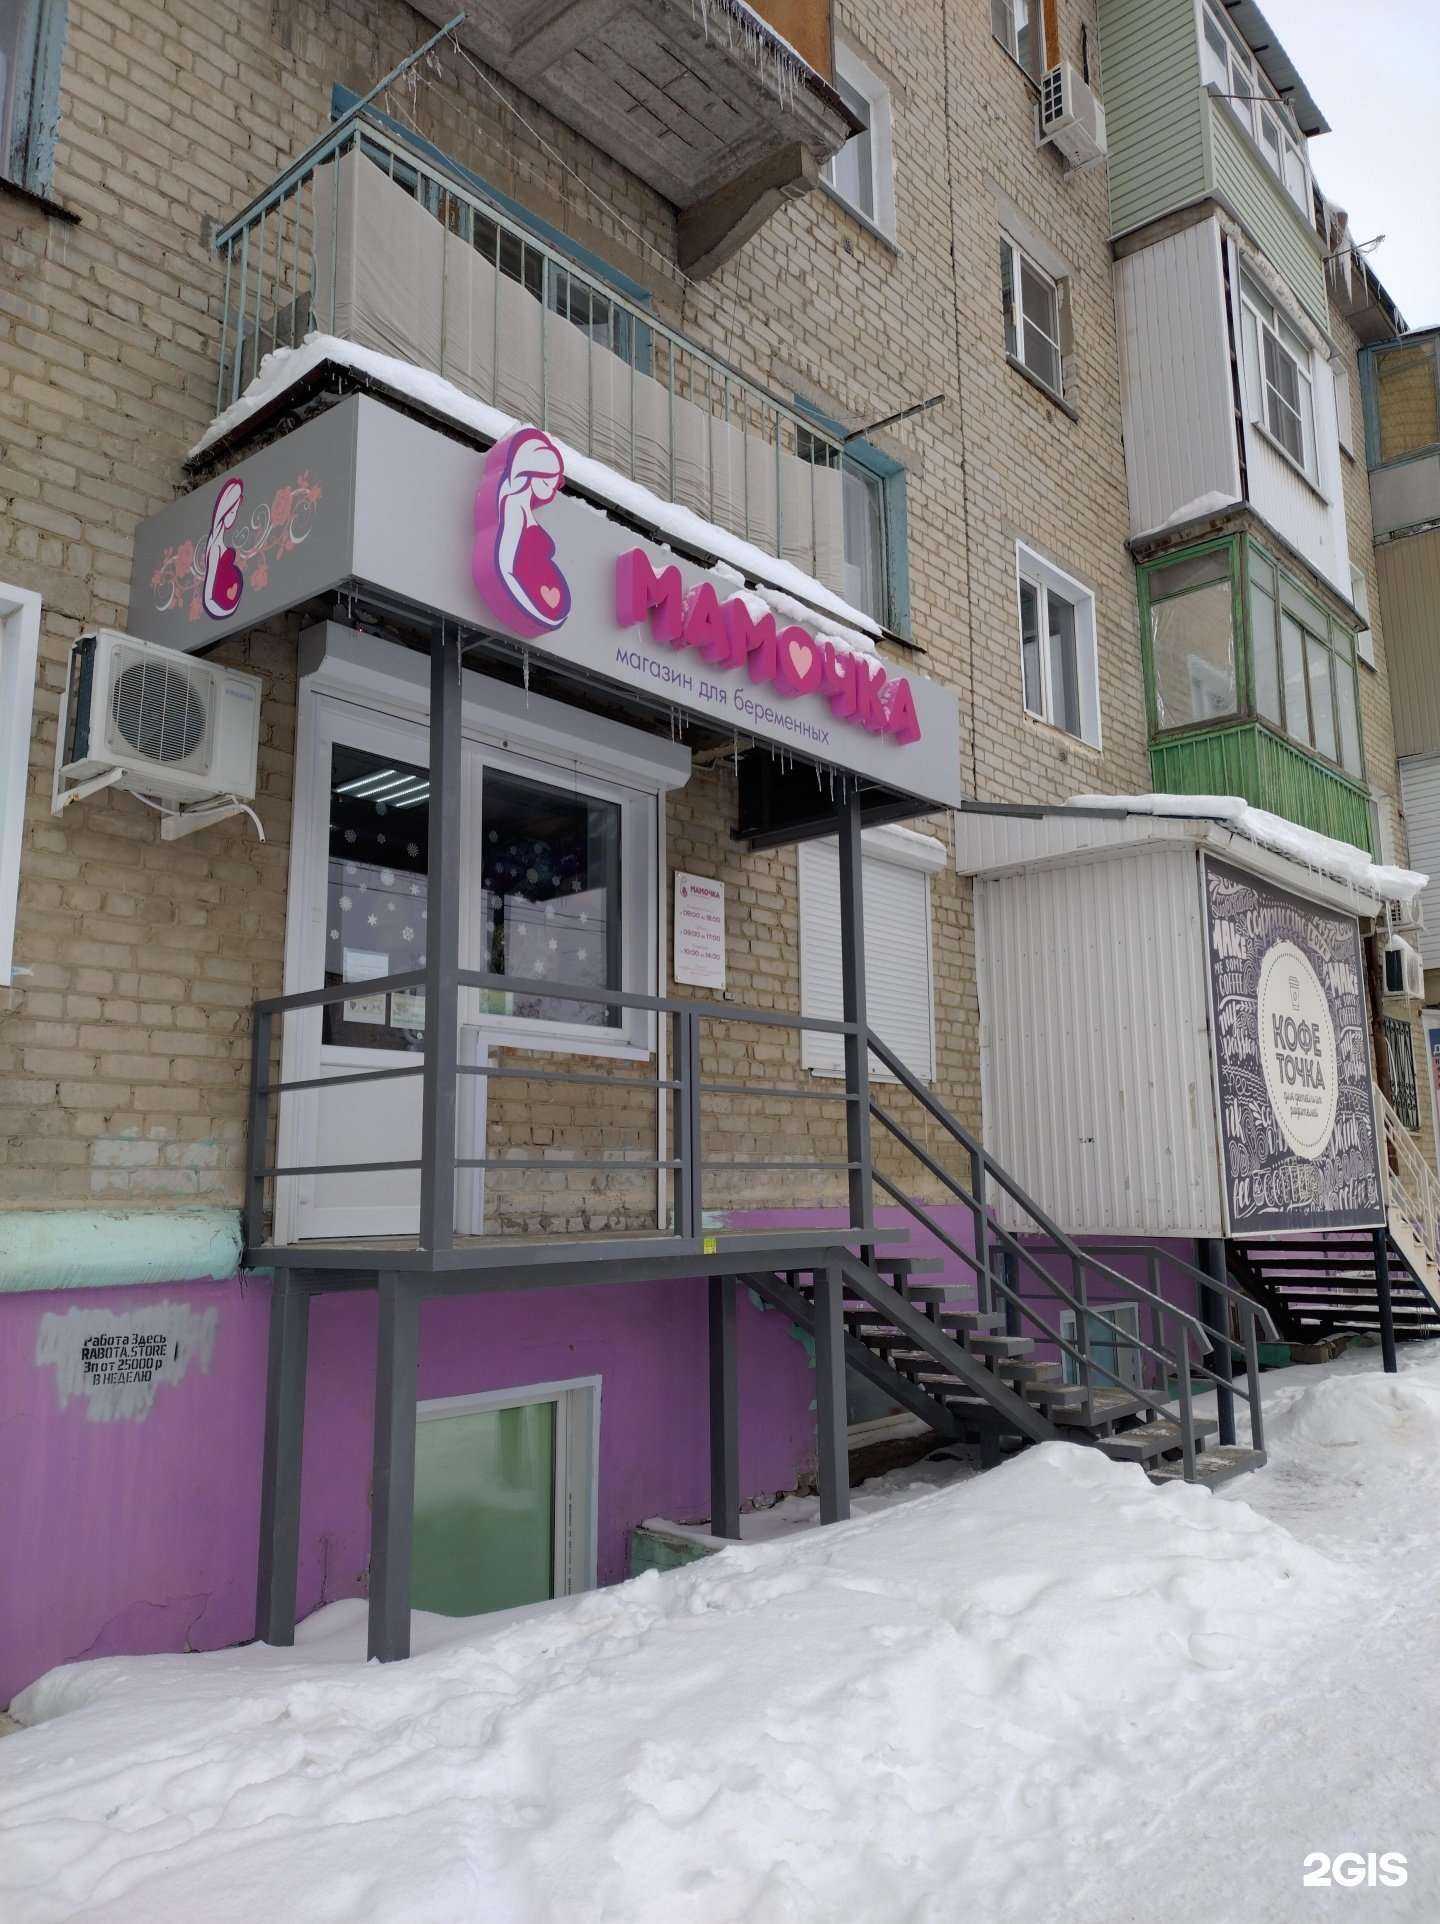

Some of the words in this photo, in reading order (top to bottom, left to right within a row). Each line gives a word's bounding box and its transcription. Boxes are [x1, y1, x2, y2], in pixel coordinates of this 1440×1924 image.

[616, 547, 922, 746] МАМОЧКА
[616, 647, 693, 692] магазин
[698, 682, 727, 706] для
[733, 688, 831, 745] беременных
[1272, 1013, 1322, 1057] КОФЕ
[1276, 1052, 1326, 1090] ТОЧКА
[81, 1345, 167, 1360] RABOTA.STORE
[131, 1333, 167, 1347] Здесь
[83, 1361, 98, 1373] Зп
[100, 1362, 116, 1373] от
[117, 1358, 154, 1371] 25000
[155, 1359, 163, 1370] р
[92, 1374, 101, 1386] В
[102, 1371, 152, 1385] НЕДЕЛЮ
